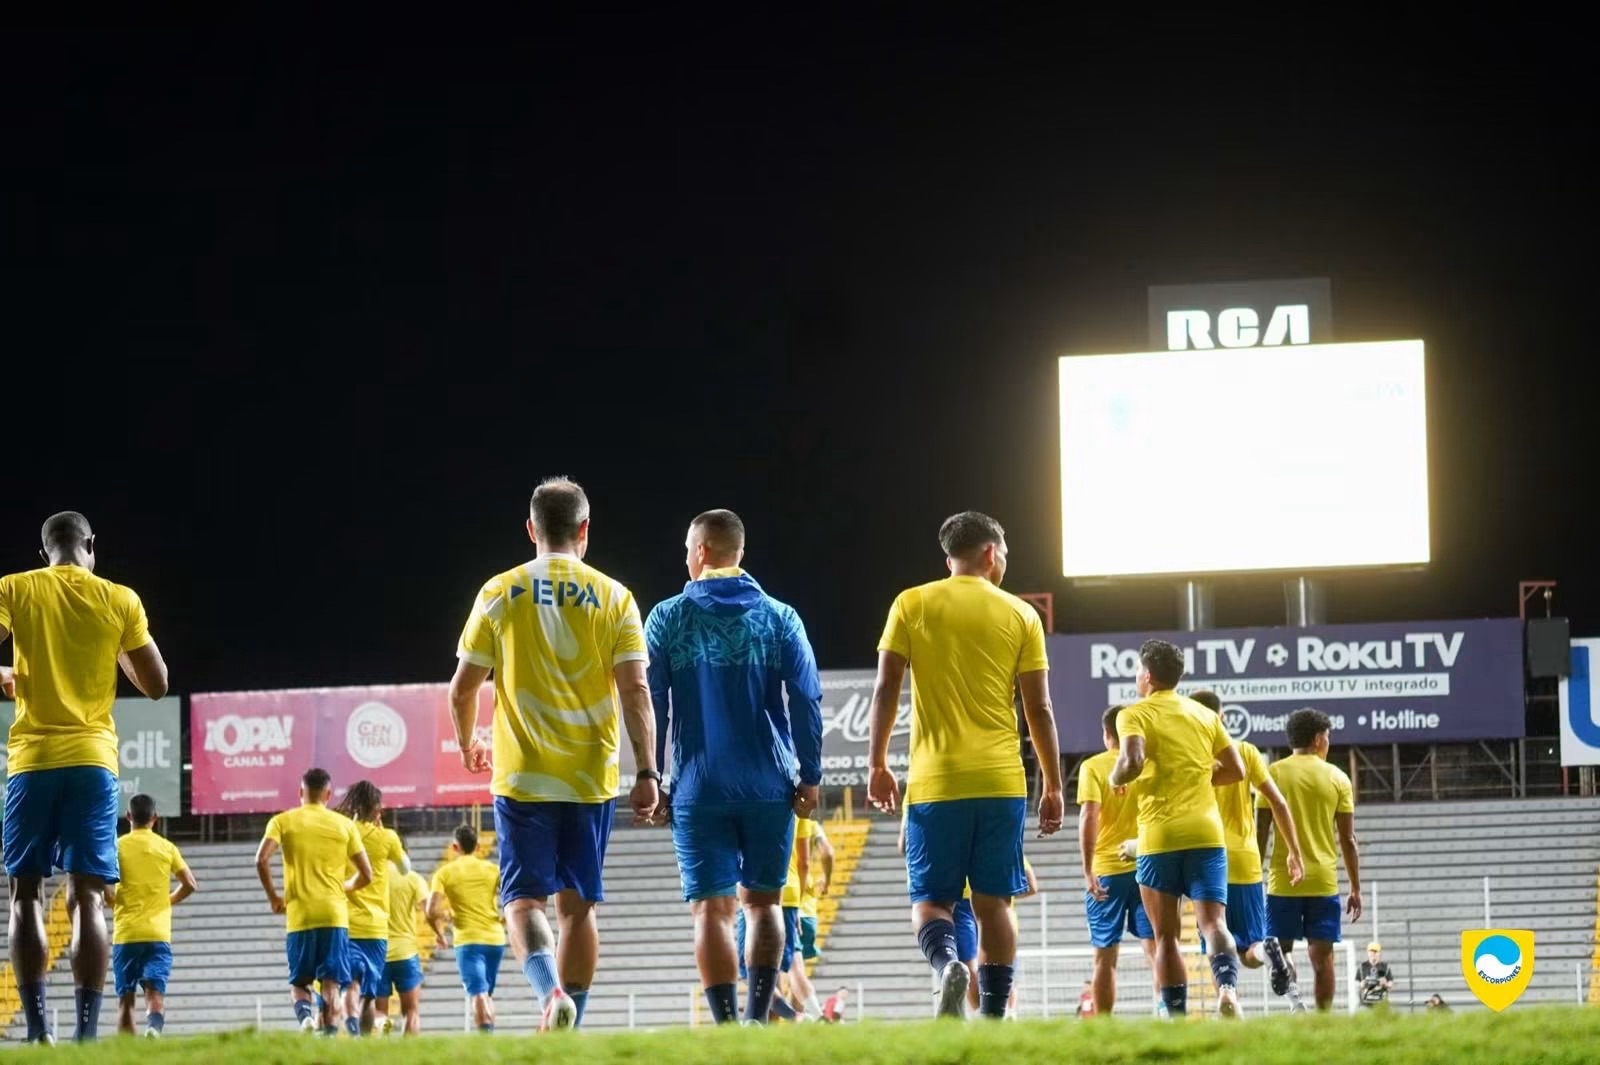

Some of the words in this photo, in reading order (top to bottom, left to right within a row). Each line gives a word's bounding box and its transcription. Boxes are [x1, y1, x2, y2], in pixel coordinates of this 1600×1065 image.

[1167, 304, 1310, 350] RCA
[533, 578, 600, 609] EPA
[1297, 636, 1402, 671] Roku
[1405, 632, 1465, 667] TV
[1239, 680, 1287, 695] tienen
[1291, 680, 1334, 693] ROKU
[1338, 679, 1358, 692] TV
[1365, 677, 1438, 693] integrado
[1372, 709, 1440, 730] Hotline
[224, 756, 266, 768] CANAL
[269, 755, 285, 765] 38
